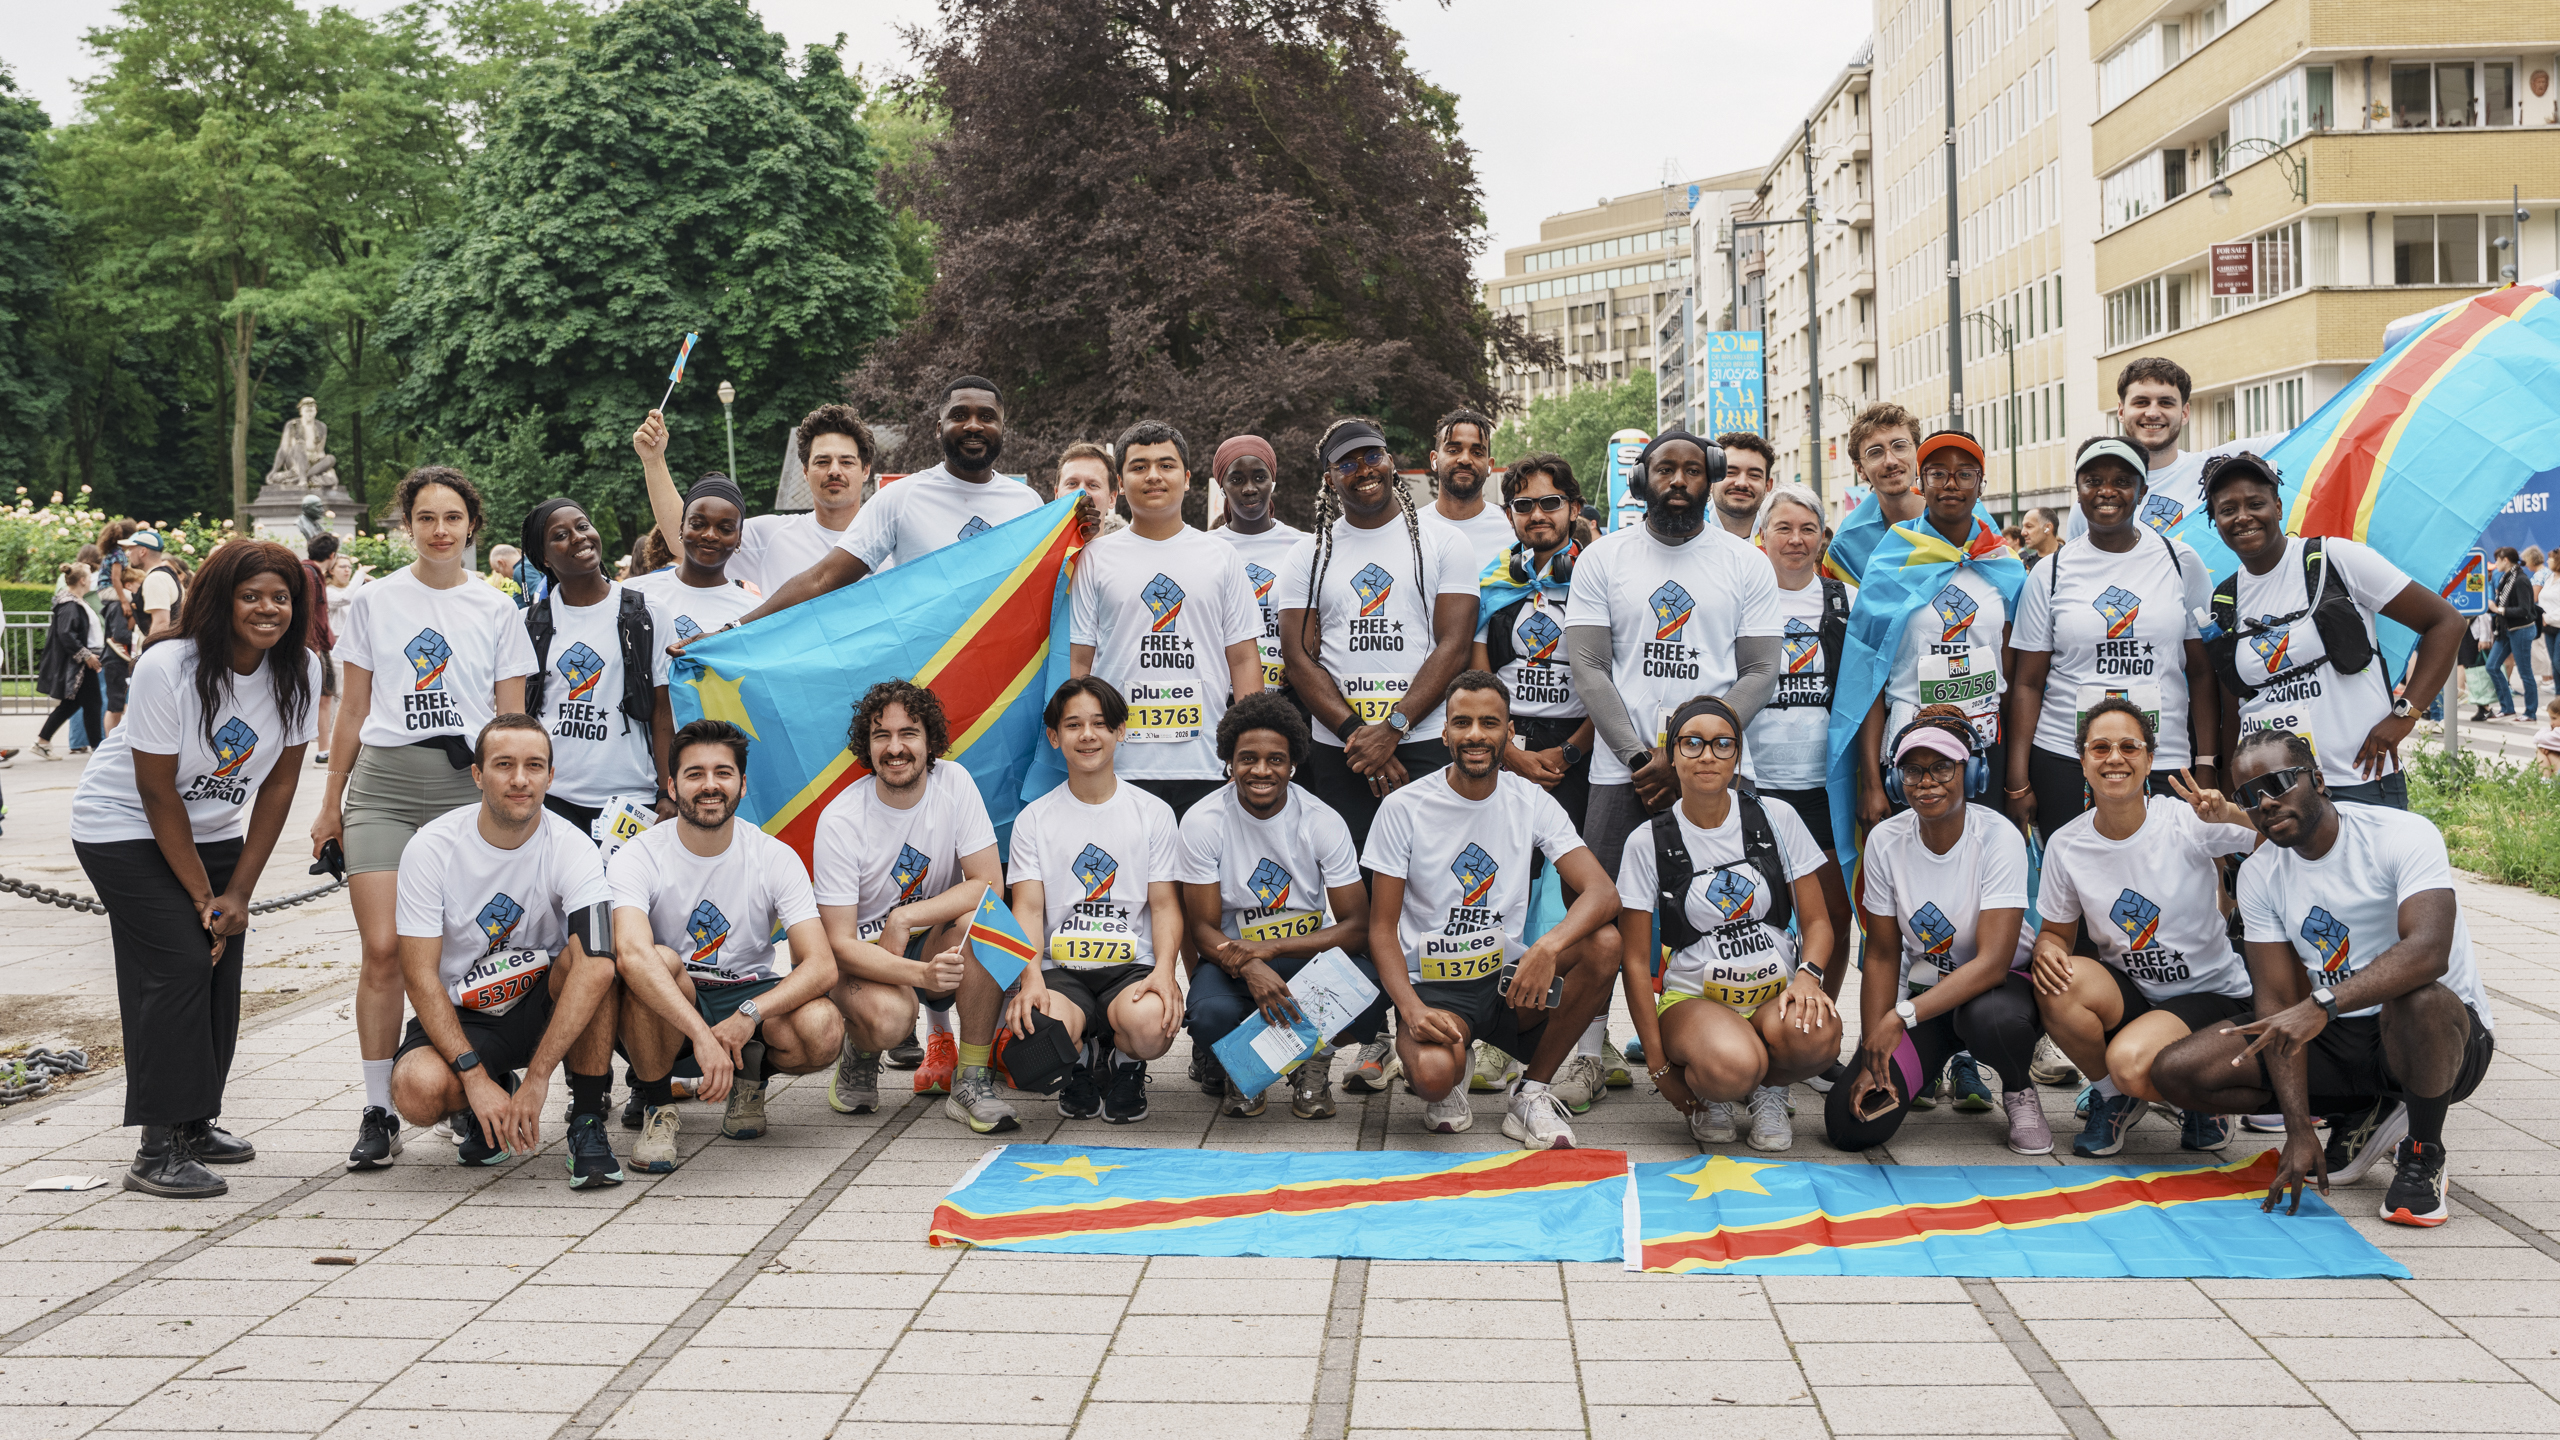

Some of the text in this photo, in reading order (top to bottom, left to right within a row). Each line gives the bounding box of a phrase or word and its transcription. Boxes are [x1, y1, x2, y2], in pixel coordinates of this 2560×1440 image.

[2216, 246, 2248, 255] FOR SALE
[1711, 368, 1760, 380] 31/05/26
[2500, 492, 2550, 514] EWEST
[1350, 618, 1388, 635] FREE
[1140, 634, 1180, 651] FREE
[1349, 635, 1404, 652] CONGO
[1644, 642, 1685, 661] FREE
[2096, 640, 2139, 657] FREE
[1140, 652, 1195, 669] CONGO
[1643, 660, 1699, 680] CONGO
[2096, 658, 2154, 676] CONGO
[1517, 668, 1555, 686] FREE
[1950, 666, 1969, 675] KIND
[1131, 684, 1194, 703] pluxee
[1346, 676, 1409, 696] pluxee
[1516, 685, 1570, 703] CONGO
[1933, 674, 1995, 701] 62756
[2265, 681, 2321, 703] CONGO
[404, 691, 450, 712] FREE
[406, 709, 464, 731] CONGO
[559, 703, 595, 722] FREE
[1139, 707, 1200, 726] 13763
[552, 720, 608, 741] CONGO
[2242, 715, 2298, 737] pluxee
[182, 787, 246, 806] CONGO
[1072, 903, 1114, 918] FREE
[1449, 907, 1490, 926] FREE
[1060, 915, 1128, 935] pluxee
[1256, 915, 1319, 941] 13762
[1066, 940, 1132, 960] 13773
[1426, 935, 1496, 956] pluxee
[1718, 932, 1775, 960] CONGO
[1436, 952, 1501, 977] 13765
[2121, 949, 2168, 968] FREE
[463, 950, 536, 989] pluxee
[1712, 962, 1778, 983] pluxee
[2127, 964, 2190, 983] CONGO
[1720, 981, 1782, 1005] 13771
